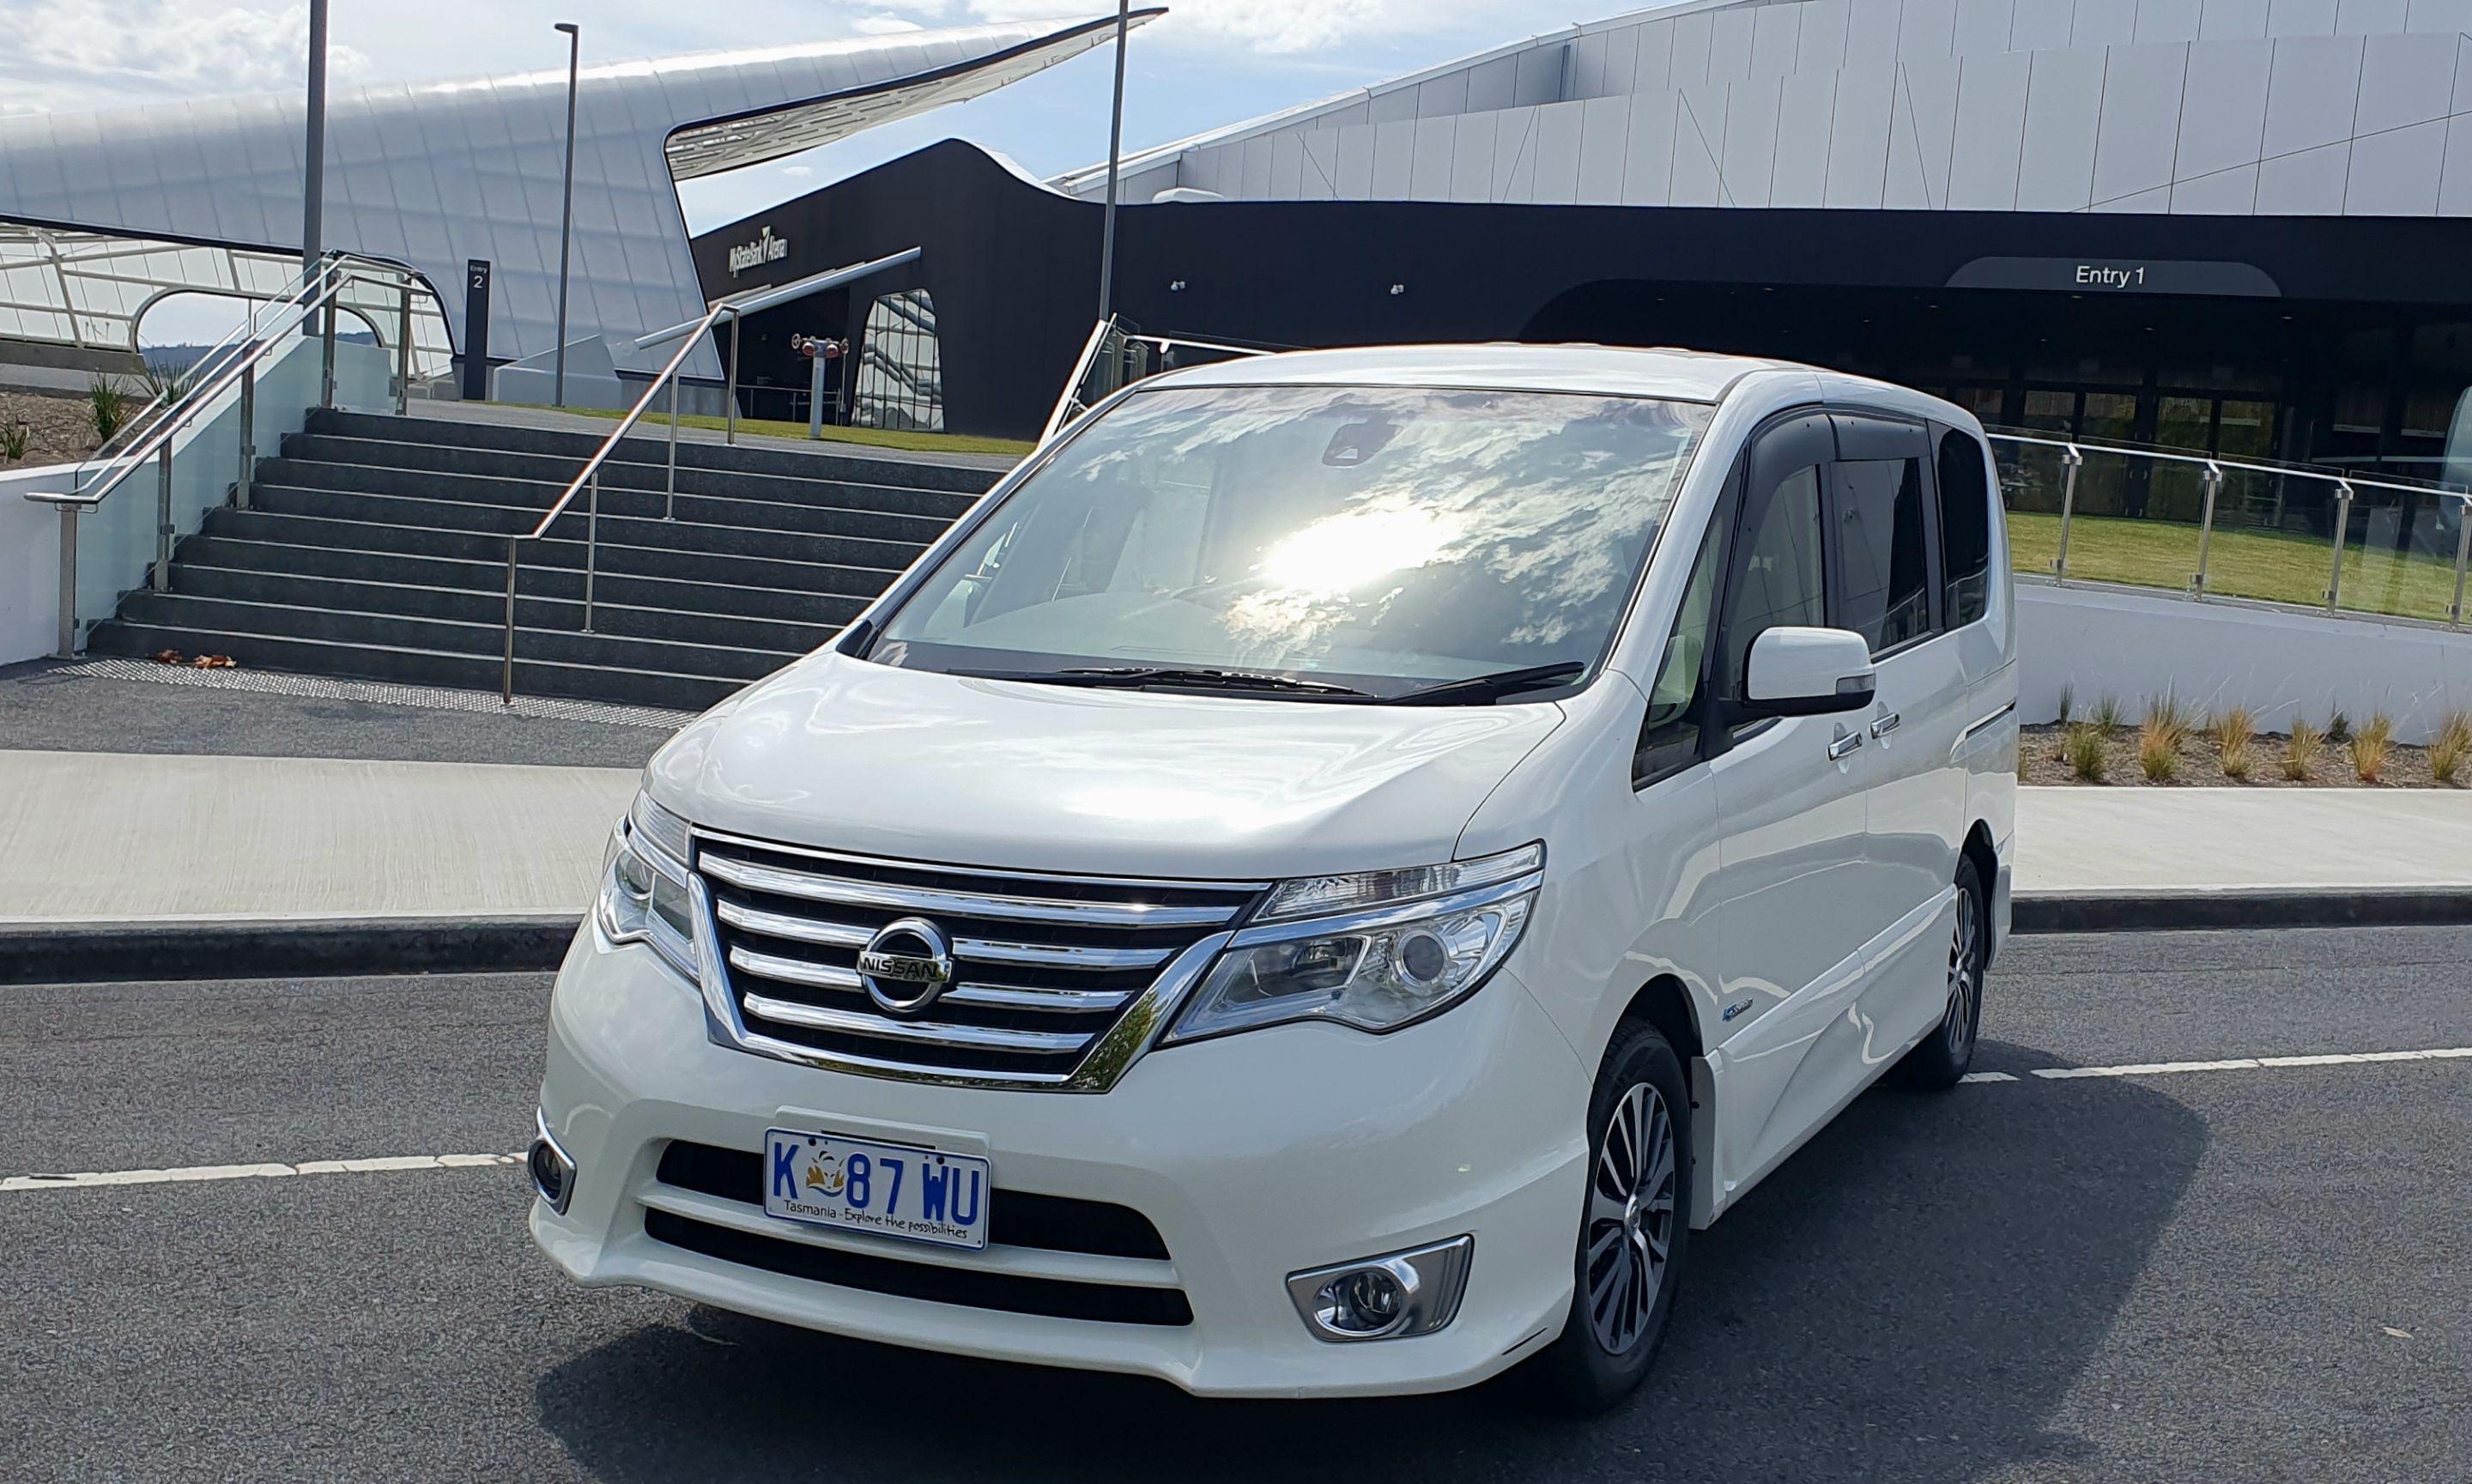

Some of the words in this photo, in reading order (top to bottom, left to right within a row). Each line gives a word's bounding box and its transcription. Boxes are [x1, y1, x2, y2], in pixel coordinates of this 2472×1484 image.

[473, 275, 483, 288] 2
[2075, 265, 2130, 288] Entry
[2136, 266, 2144, 284] 1
[863, 957, 937, 978] NISSAN
[773, 1142, 799, 1199] K
[846, 1153, 904, 1214] 87
[923, 1163, 979, 1226] WU
[784, 1200, 837, 1219] Tasmania
[845, 1208, 882, 1226] Explore
[886, 1213, 906, 1229] the
[908, 1221, 968, 1239] possibilities
